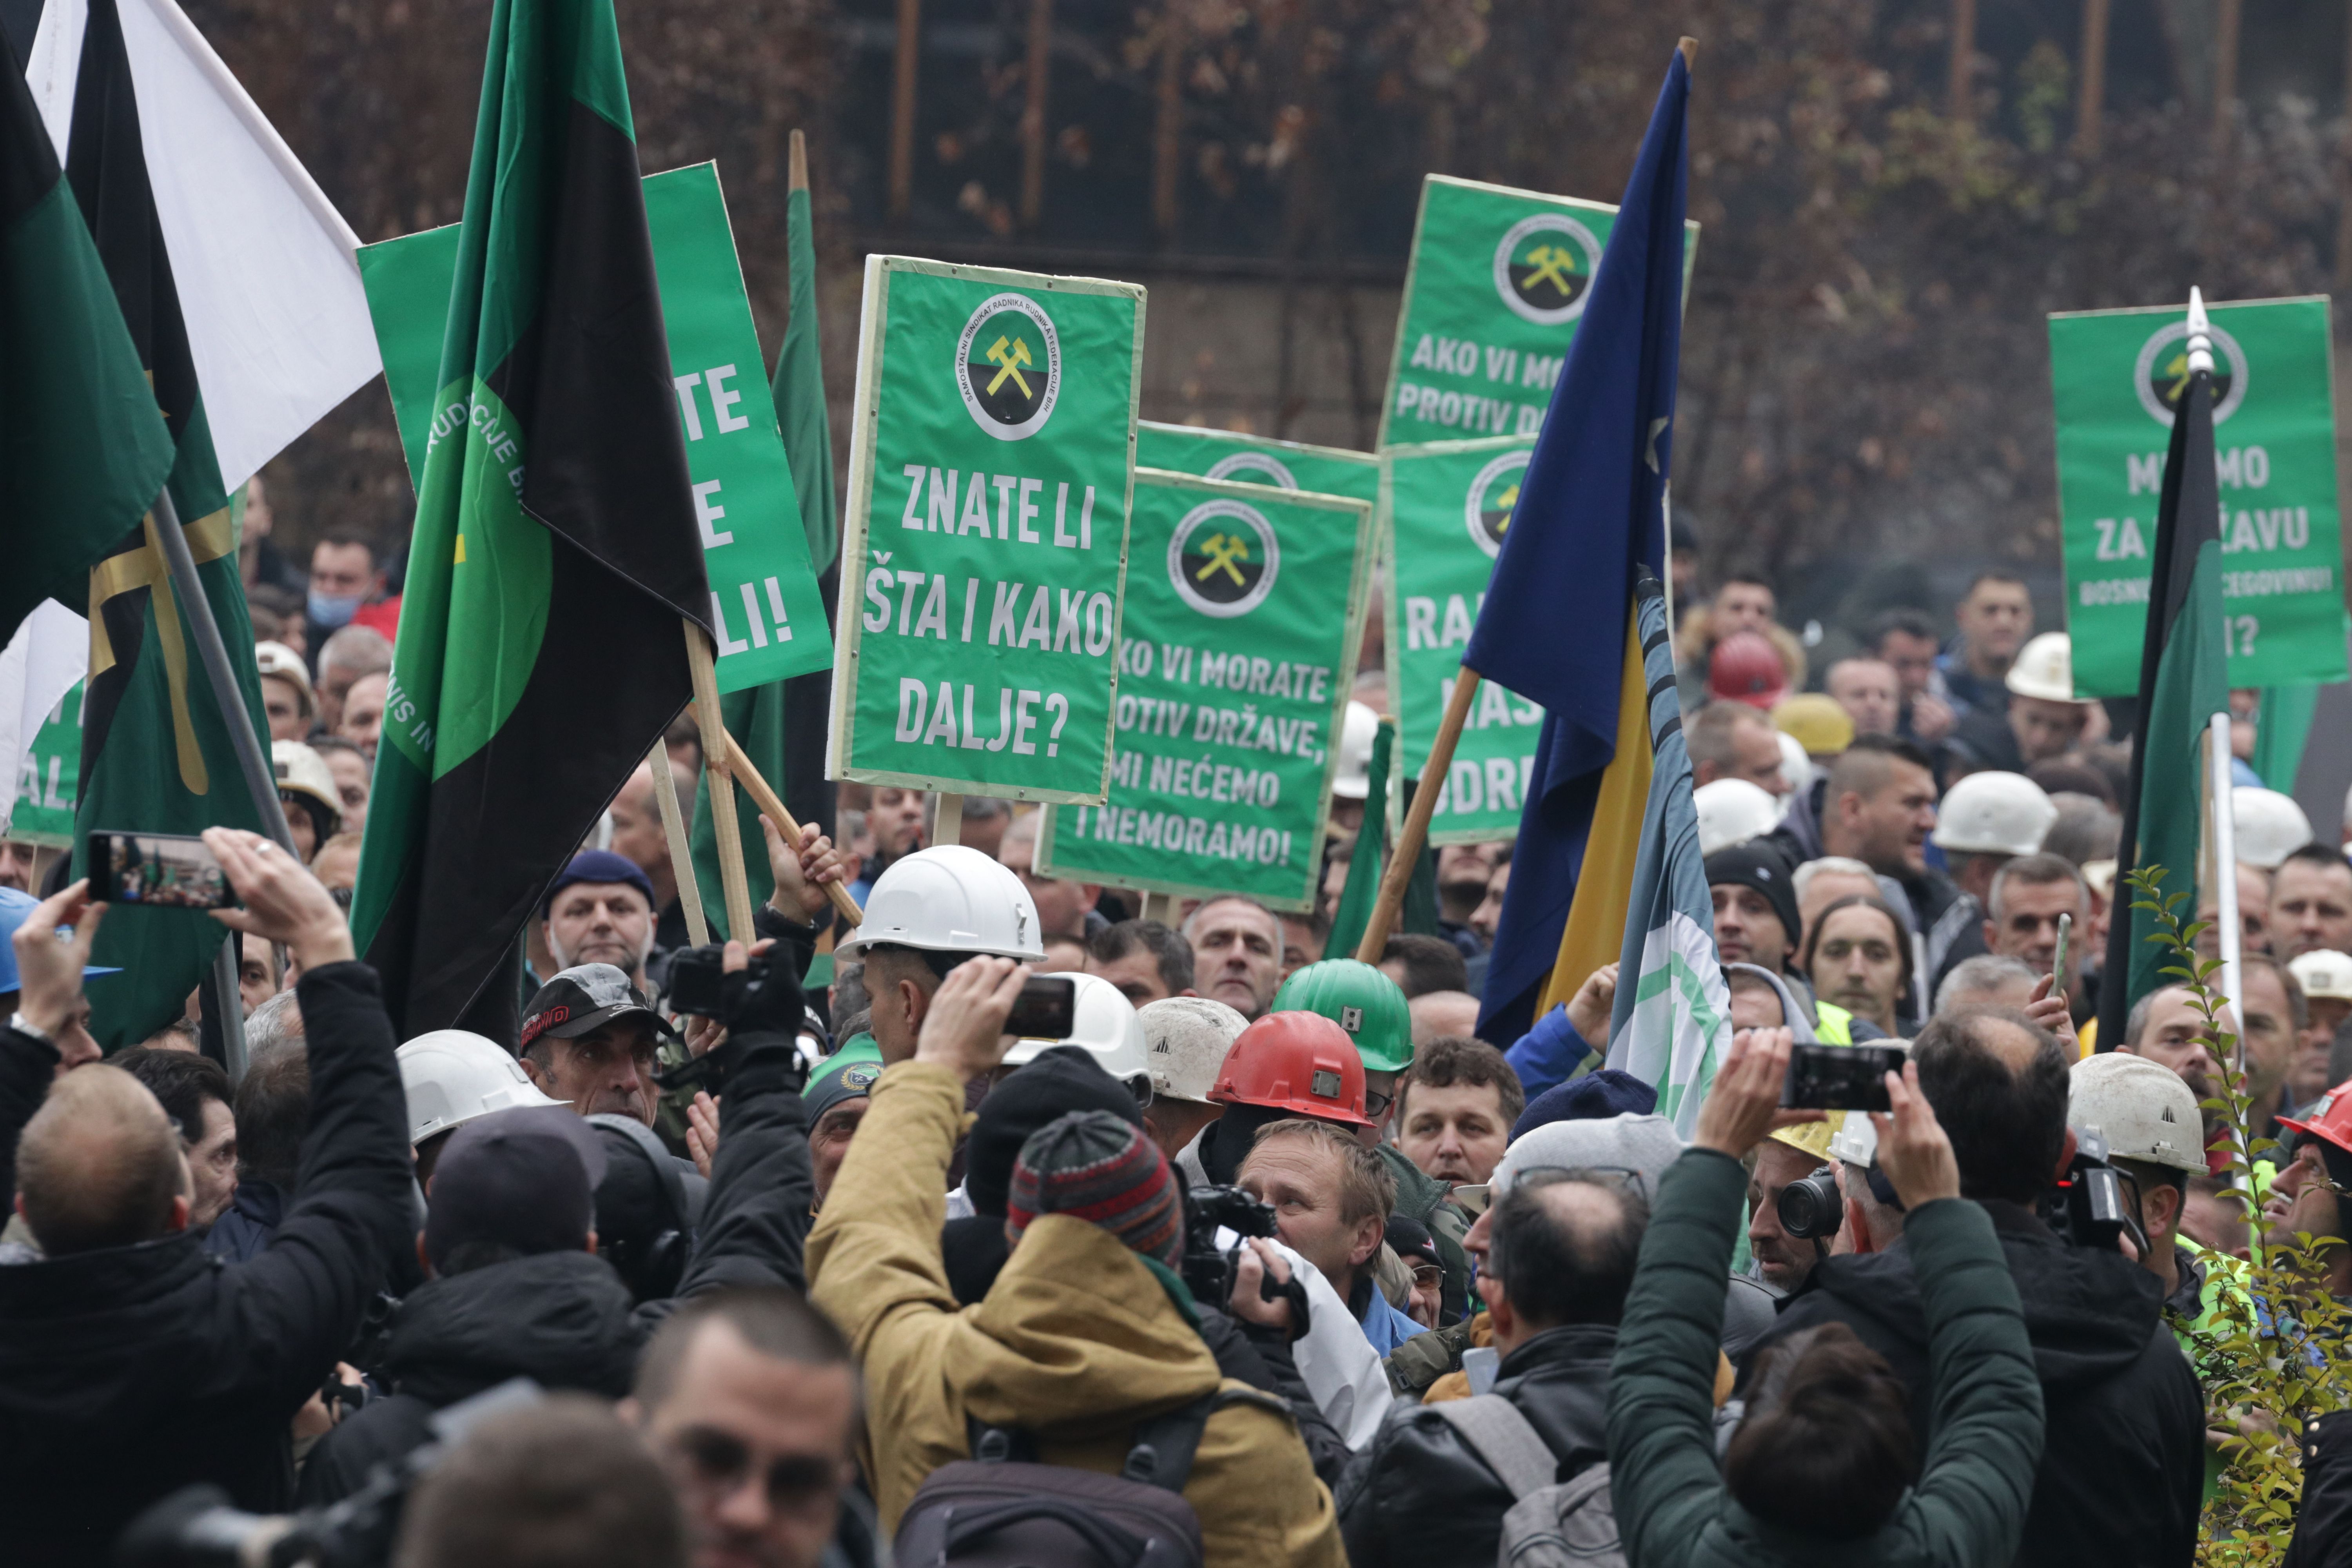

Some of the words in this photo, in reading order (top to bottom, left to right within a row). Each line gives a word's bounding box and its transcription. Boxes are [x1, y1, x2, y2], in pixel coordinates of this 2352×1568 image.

[965, 305, 992, 339] SINDIKAT
[993, 298, 1024, 310] RADNIKA
[1025, 303, 1051, 336] RUDNIKA
[958, 340, 973, 402] SAMOSTALNI
[1048, 335, 1058, 395] FEDERACIJE
[1410, 333, 1479, 377] AKO
[1485, 345, 1518, 384] VI
[673, 363, 750, 442] TE
[1043, 395, 1053, 413] BIH
[1396, 383, 1514, 434] PROTIV
[692, 478, 735, 550] E
[902, 464, 1043, 544] ZNATE
[1053, 481, 1095, 550] LI
[2093, 516, 2147, 561] ZA
[710, 576, 793, 657] LI!
[862, 550, 947, 640] ŠTA
[961, 577, 979, 643] I
[988, 582, 1112, 657] KAKO
[1118, 637, 1154, 677] KO
[1162, 643, 1194, 684] VI
[1199, 649, 1331, 703] MORATE
[895, 677, 1069, 758] DALJE?
[1116, 694, 1191, 739] OTIV
[1192, 703, 1325, 767] DRŽAVE,
[1149, 753, 1281, 808] NEĆEMO
[1094, 804, 1292, 868] NEMORAMO!
